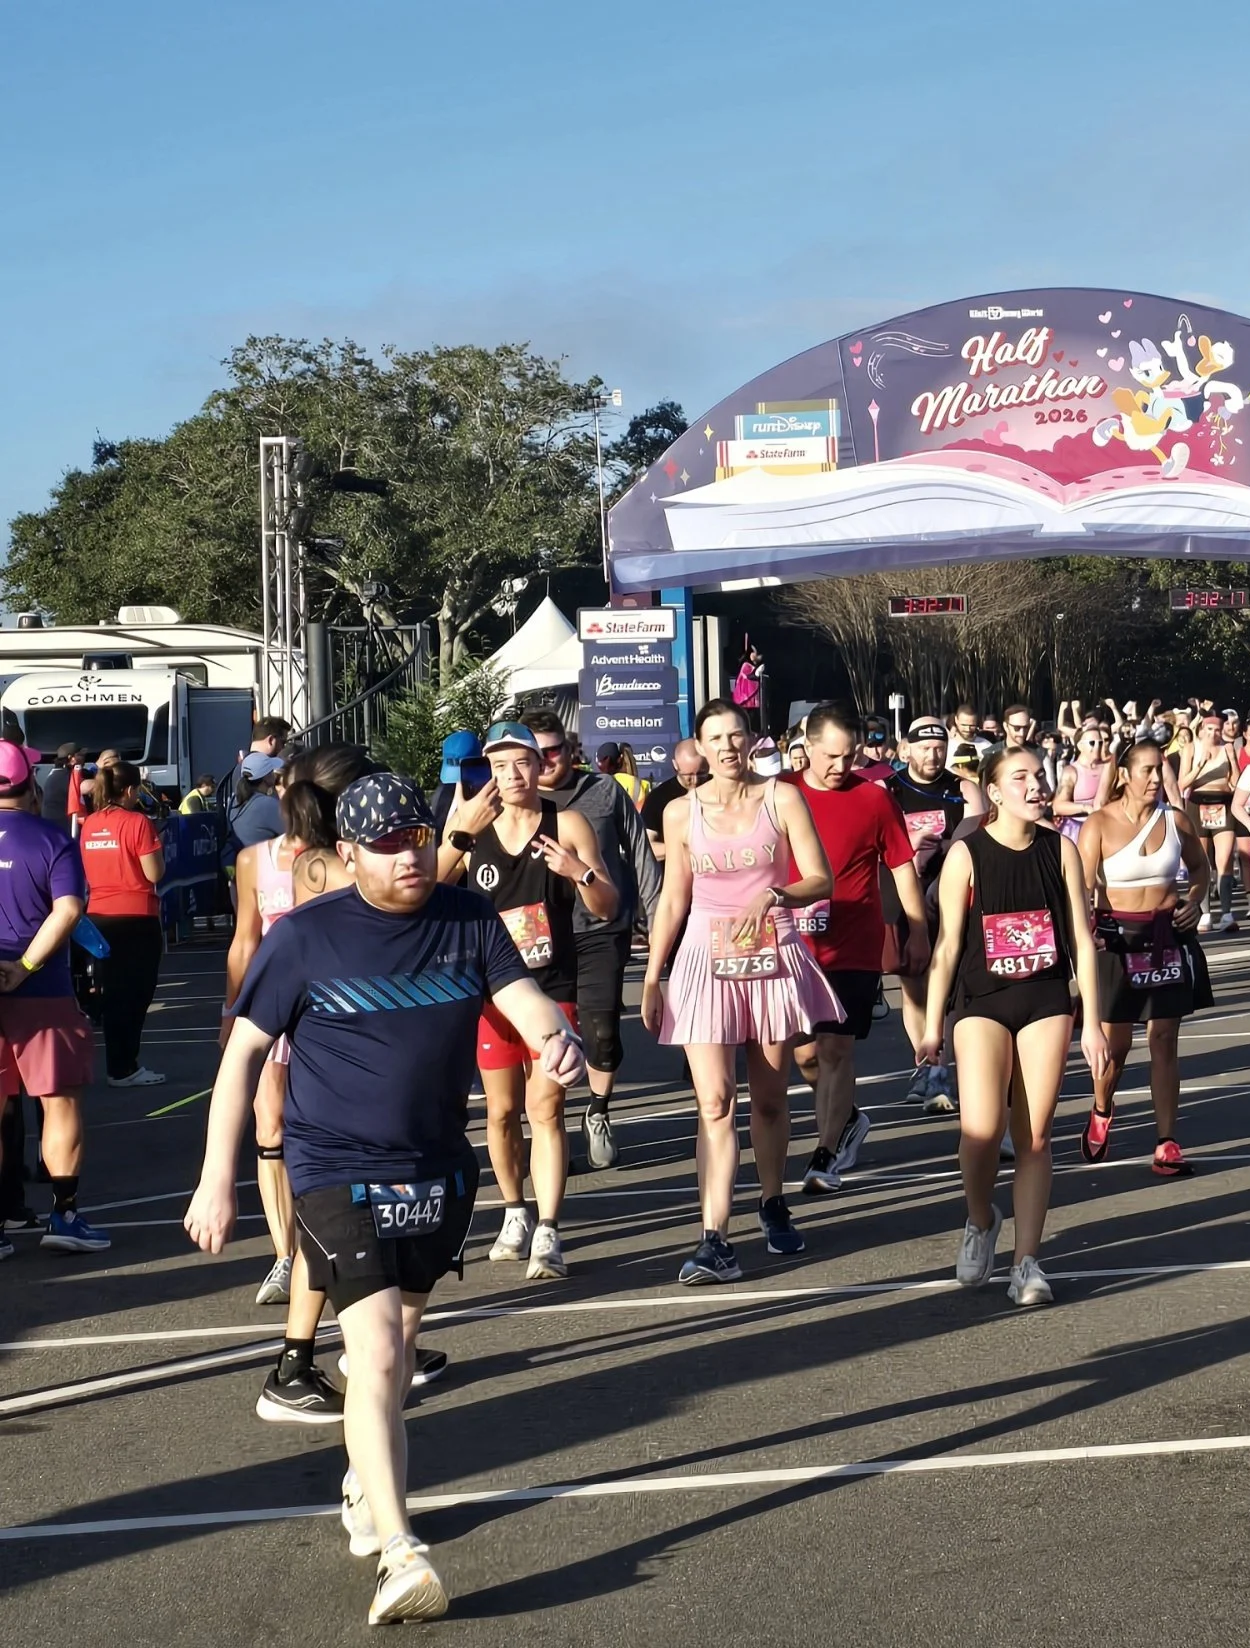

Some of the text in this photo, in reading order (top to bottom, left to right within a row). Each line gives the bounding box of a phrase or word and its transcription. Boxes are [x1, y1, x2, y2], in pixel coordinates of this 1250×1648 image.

[961, 326, 1052, 378] Half
[911, 368, 1106, 434] Marathon
[752, 415, 823, 436] runDisney
[1034, 408, 1088, 425] 2026
[591, 654, 665, 665] AdventHealth
[596, 674, 662, 697] Bauducco
[27, 694, 143, 706] COACHMEN
[690, 843, 777, 874] DAISY
[796, 918, 828, 932] 885
[714, 955, 776, 976] 25736
[990, 953, 1054, 975] 48173
[1131, 967, 1181, 984] 47629
[377, 1198, 441, 1229] 30442
